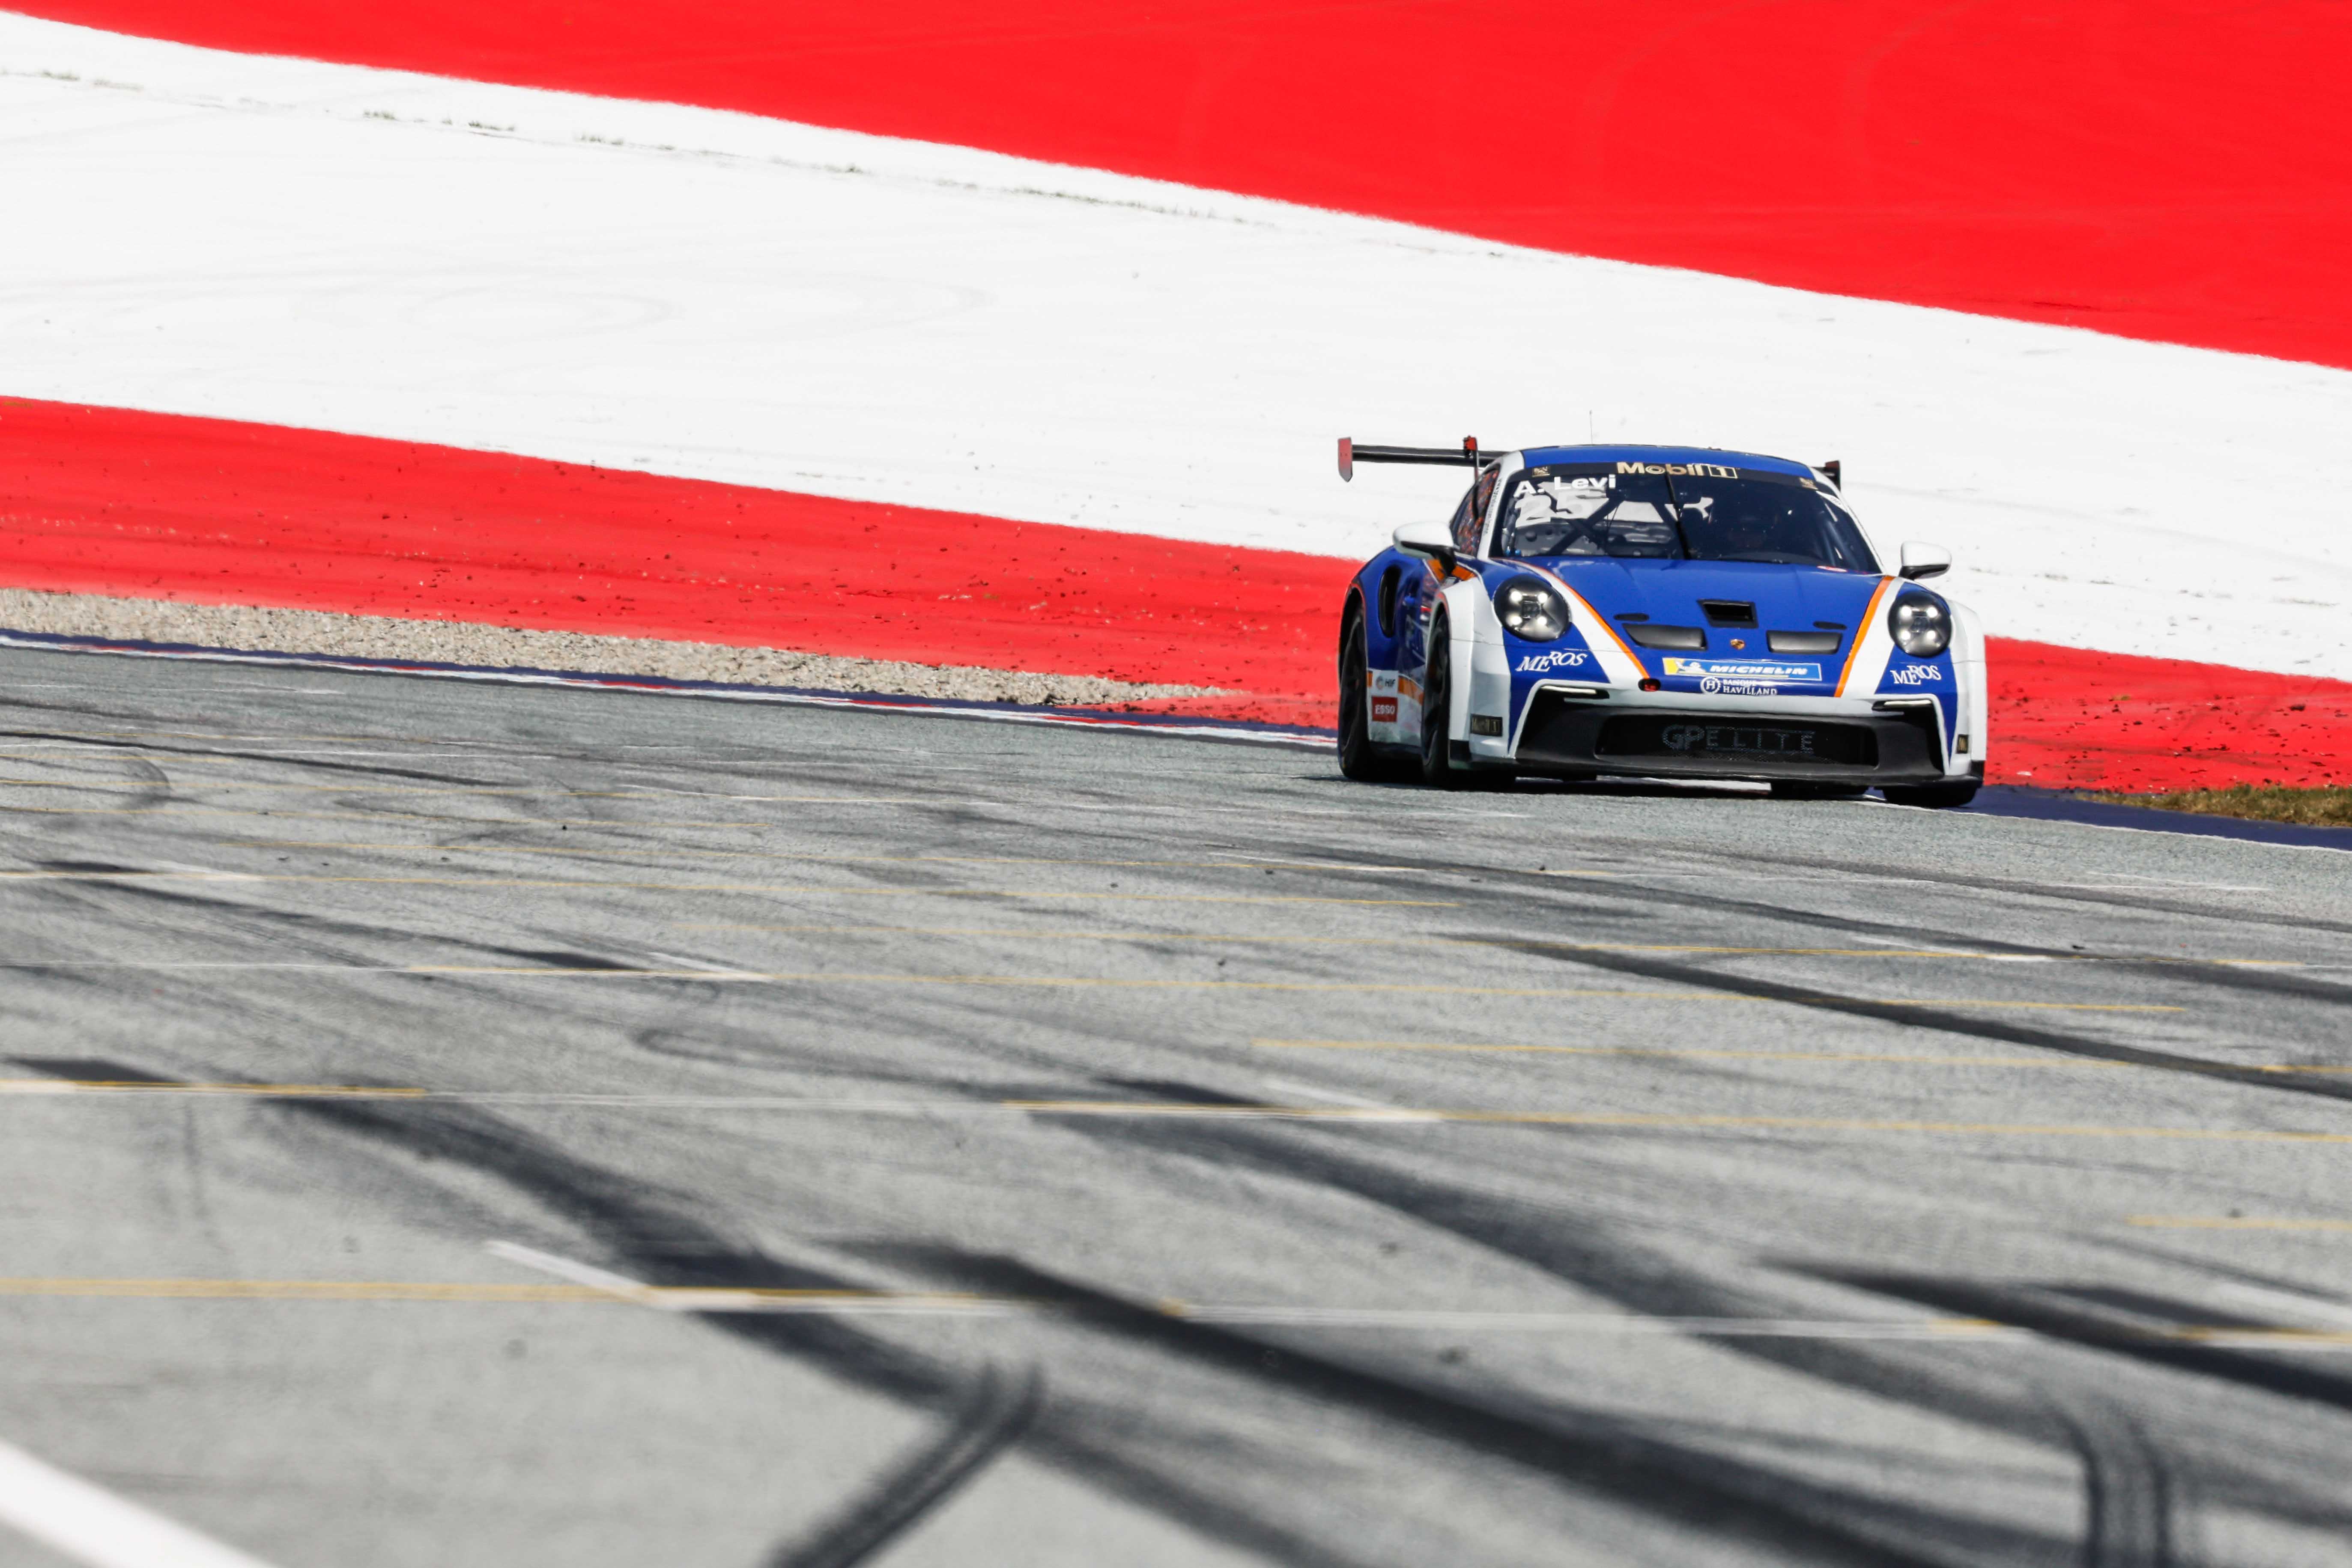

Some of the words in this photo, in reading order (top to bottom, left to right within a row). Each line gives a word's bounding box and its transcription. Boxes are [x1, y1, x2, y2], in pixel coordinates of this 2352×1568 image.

[1617, 462, 1704, 476] Mobil
[1513, 480, 1545, 498] A.
[1554, 474, 1616, 490] Levi
[1515, 651, 1588, 672] MEROS
[1710, 665, 1808, 675] MICHELIN
[1890, 665, 1942, 685] MEROS
[1723, 686, 1778, 696] HAVILLAND
